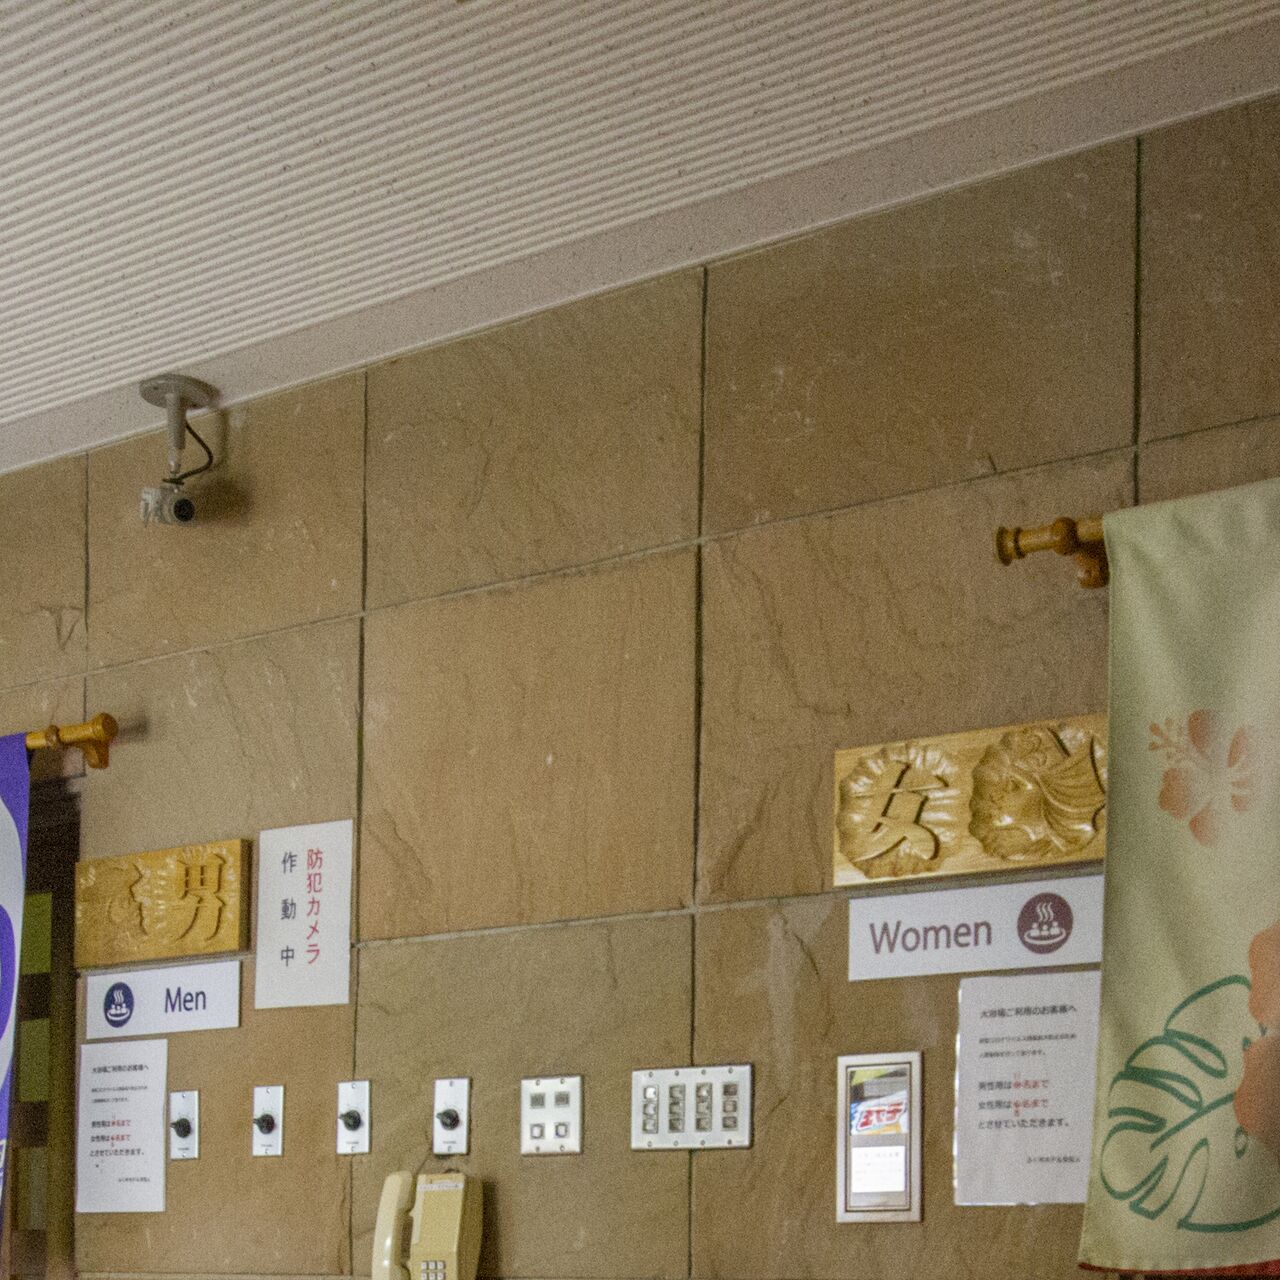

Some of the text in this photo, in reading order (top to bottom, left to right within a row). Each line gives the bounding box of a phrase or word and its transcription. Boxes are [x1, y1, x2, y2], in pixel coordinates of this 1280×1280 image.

[850, 762, 950, 862] 女
[280, 851, 298, 967] 作動中
[306, 848, 324, 966] 防犯カメラ
[869, 918, 993, 955] Women
[164, 986, 207, 1013] Men
